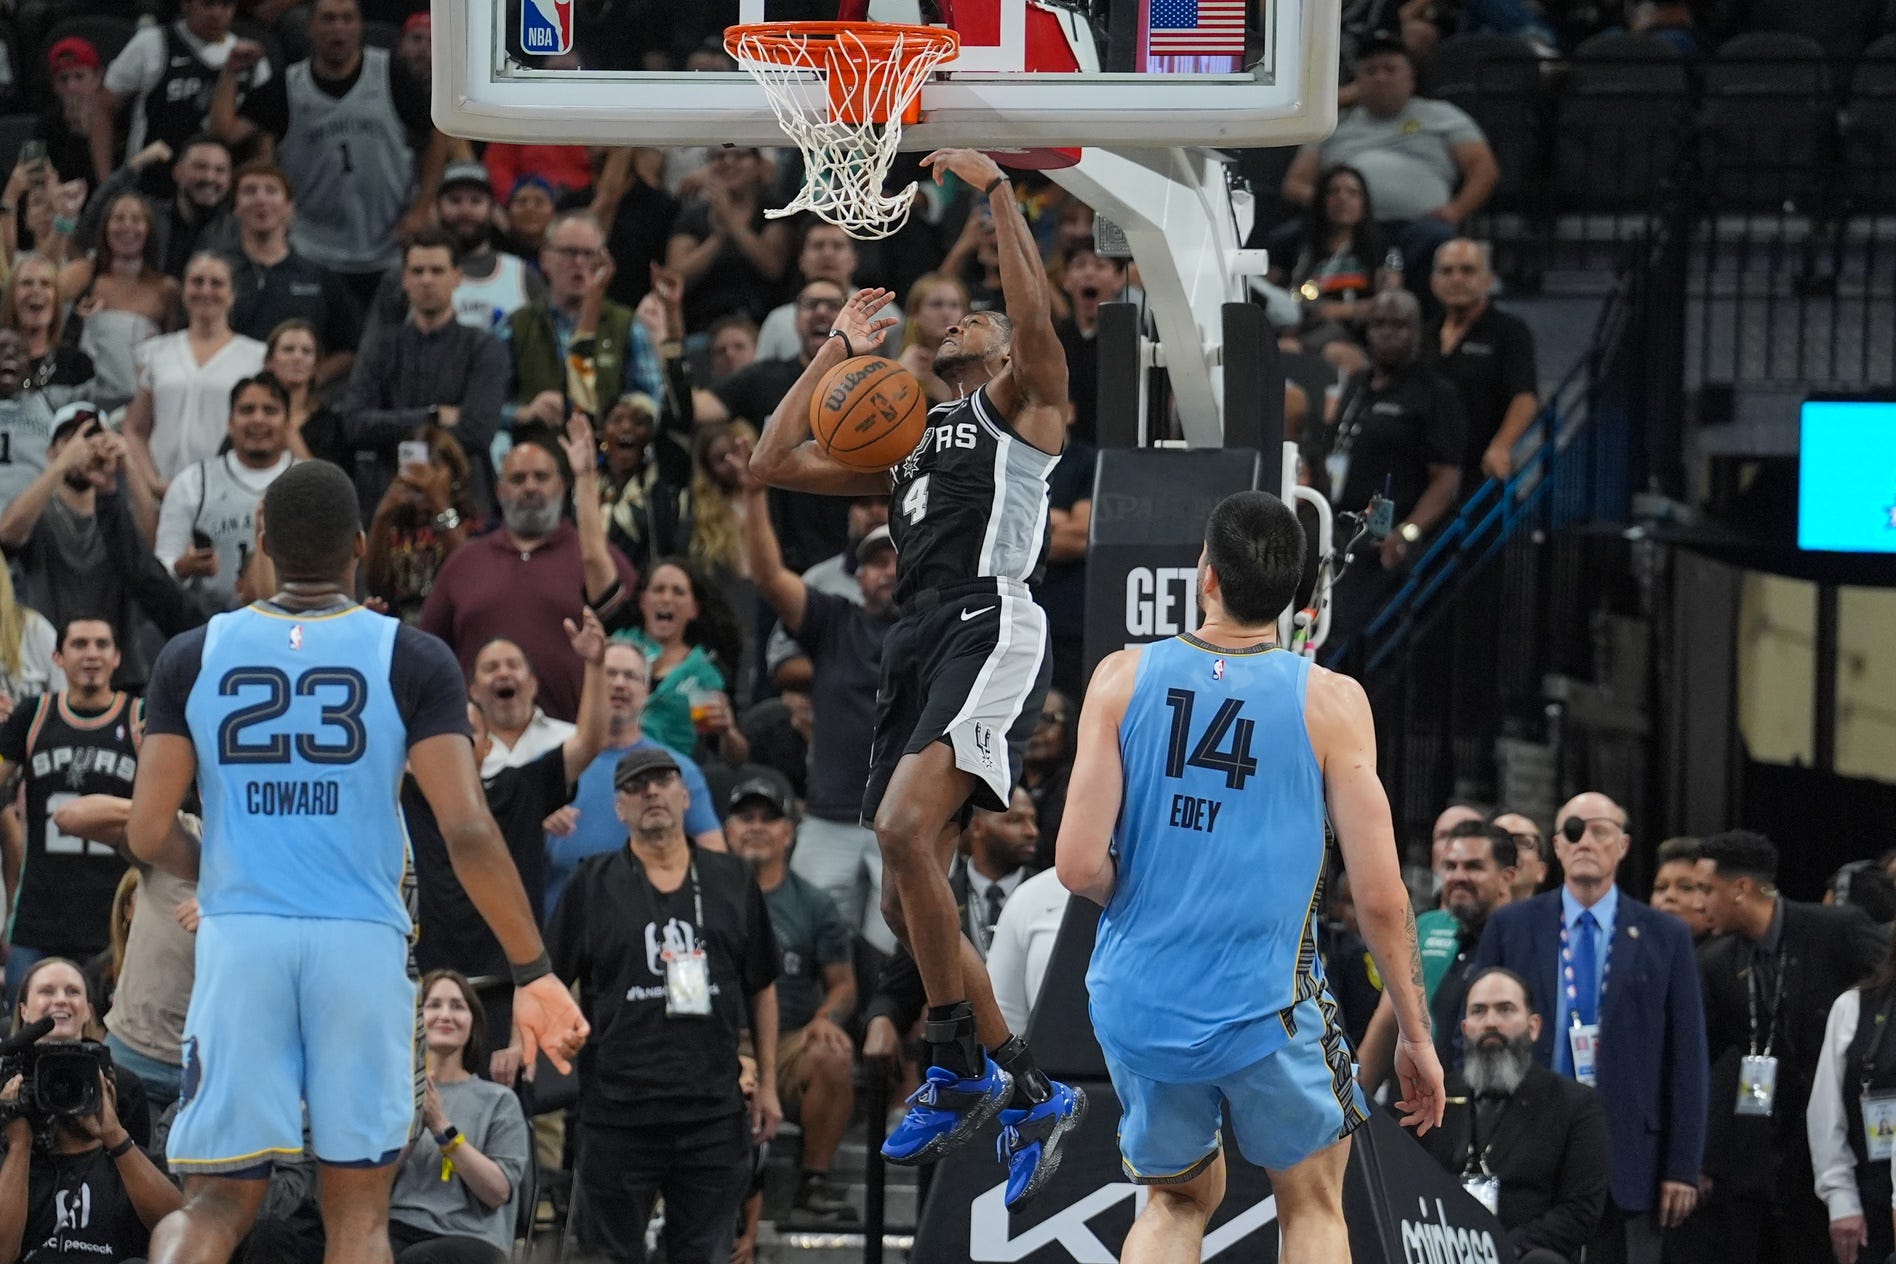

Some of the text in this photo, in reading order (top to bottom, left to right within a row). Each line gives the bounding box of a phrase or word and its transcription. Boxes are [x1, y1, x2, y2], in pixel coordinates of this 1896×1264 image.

[528, 27, 553, 46] NBA
[825, 360, 888, 412] Wilson
[902, 473, 930, 525] 4
[1125, 567, 1198, 636] GET
[217, 666, 367, 765] 23
[1165, 687, 1258, 790] 14
[32, 746, 137, 788] SPURS
[246, 780, 339, 816] COWARD
[1169, 793, 1222, 833] EDEY
[64, 1239, 113, 1255] peacock
[1401, 1195, 1500, 1264] coinbase
